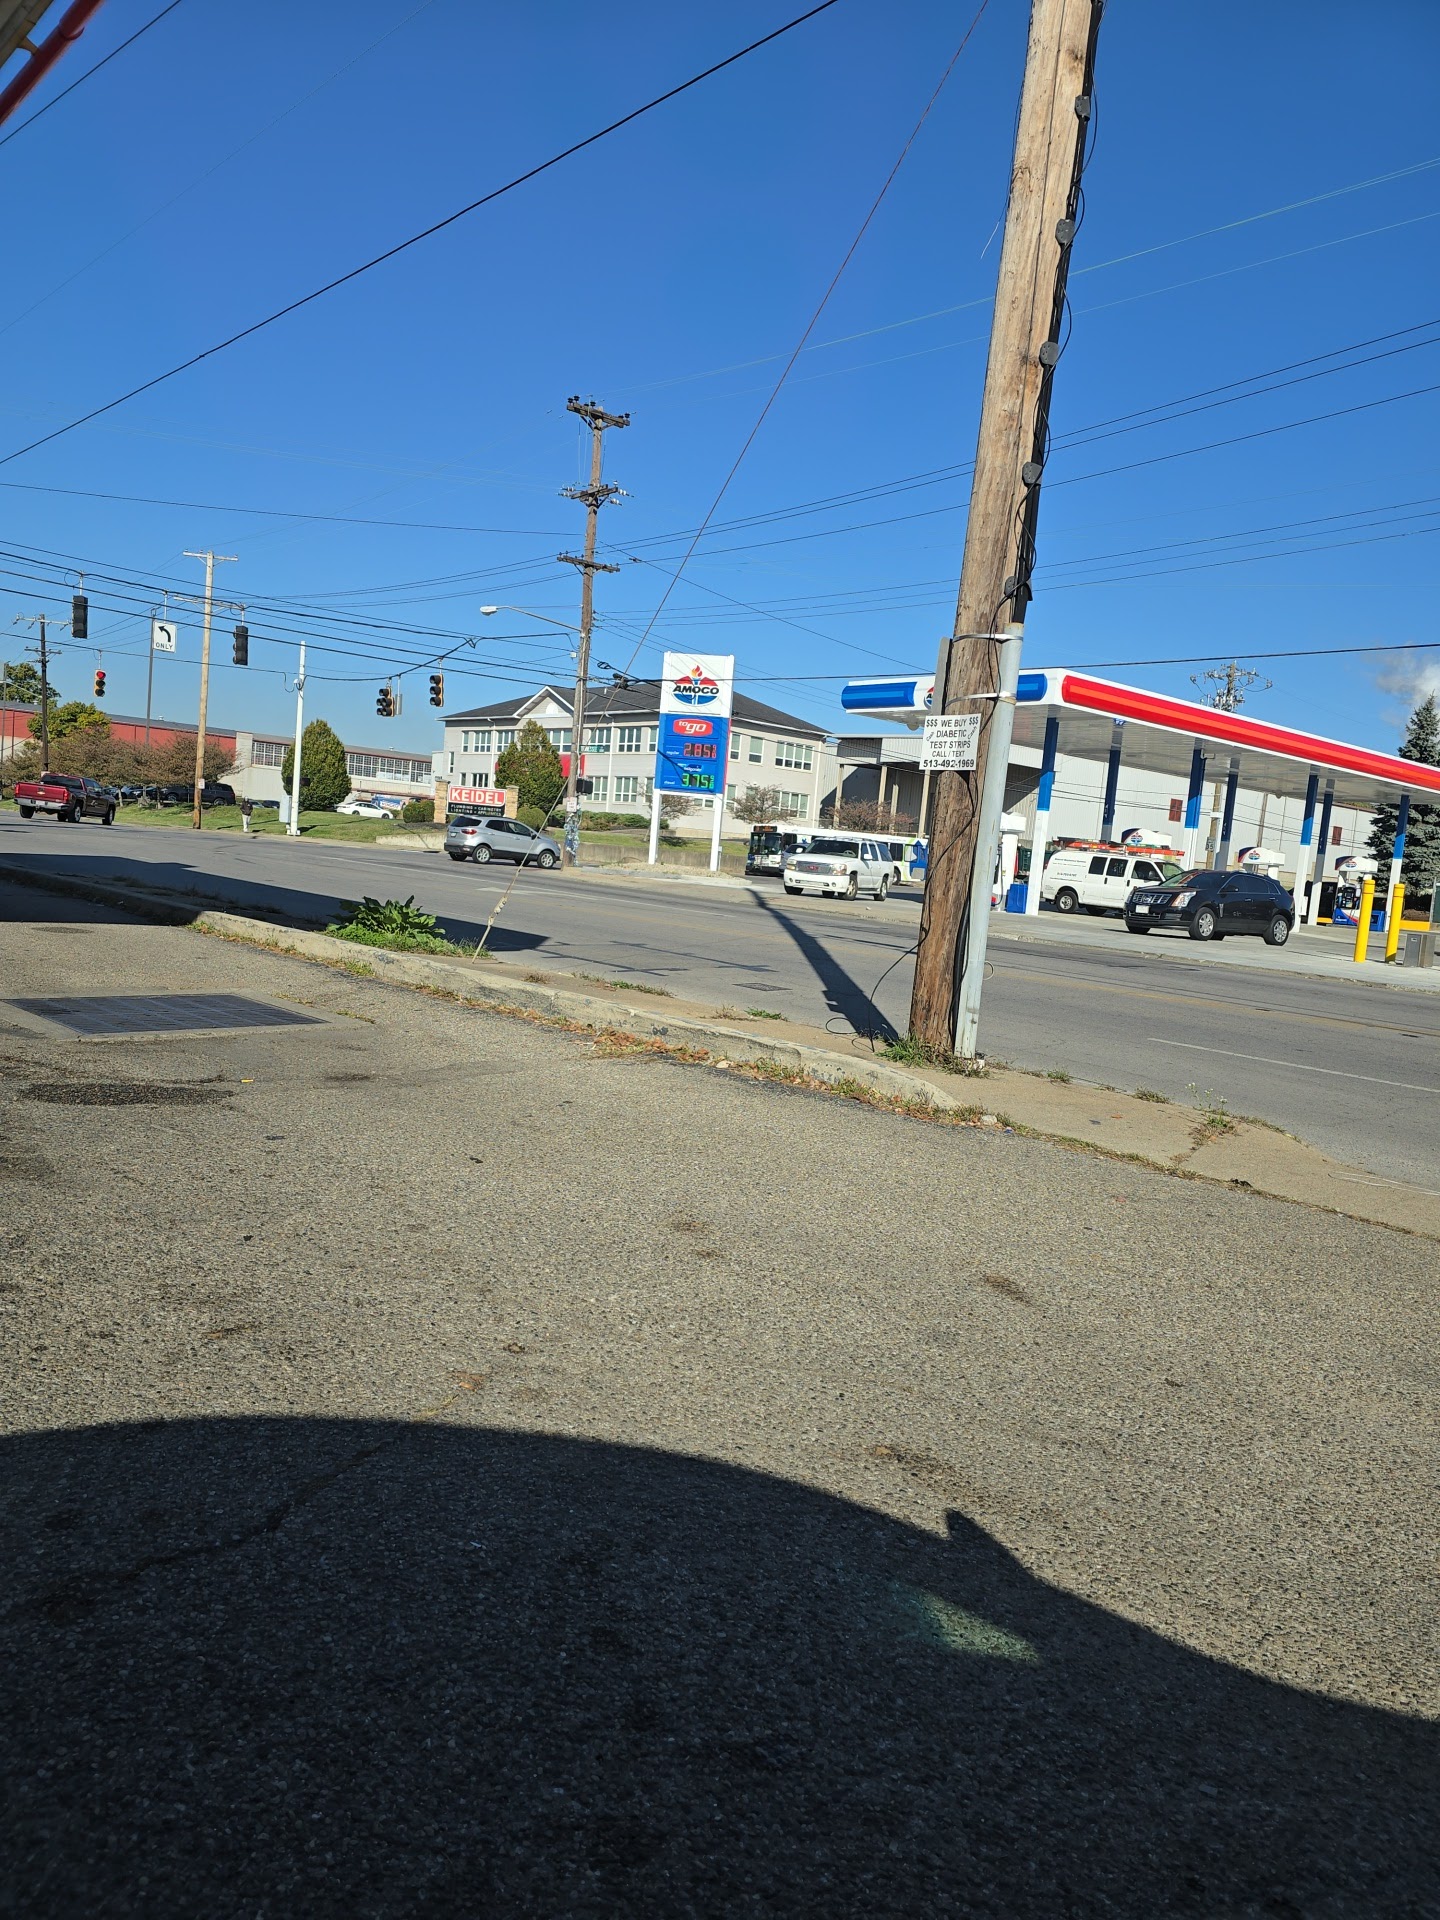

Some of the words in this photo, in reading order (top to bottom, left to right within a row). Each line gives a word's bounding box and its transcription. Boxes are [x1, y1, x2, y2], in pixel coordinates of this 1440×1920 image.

[155, 642, 173, 650] ONLY
[673, 685, 719, 695] AMOCO
[926, 719, 938, 728] $$$
[954, 719, 967, 727] BUY
[969, 716, 979, 725] $$$
[684, 723, 706, 734] go
[936, 730, 967, 738] DIABETIC
[930, 741, 947, 749] TEST
[949, 741, 971, 749] STRIPS
[923, 759, 975, 768] 513-492-1969
[451, 788, 503, 805] KEIDEL
